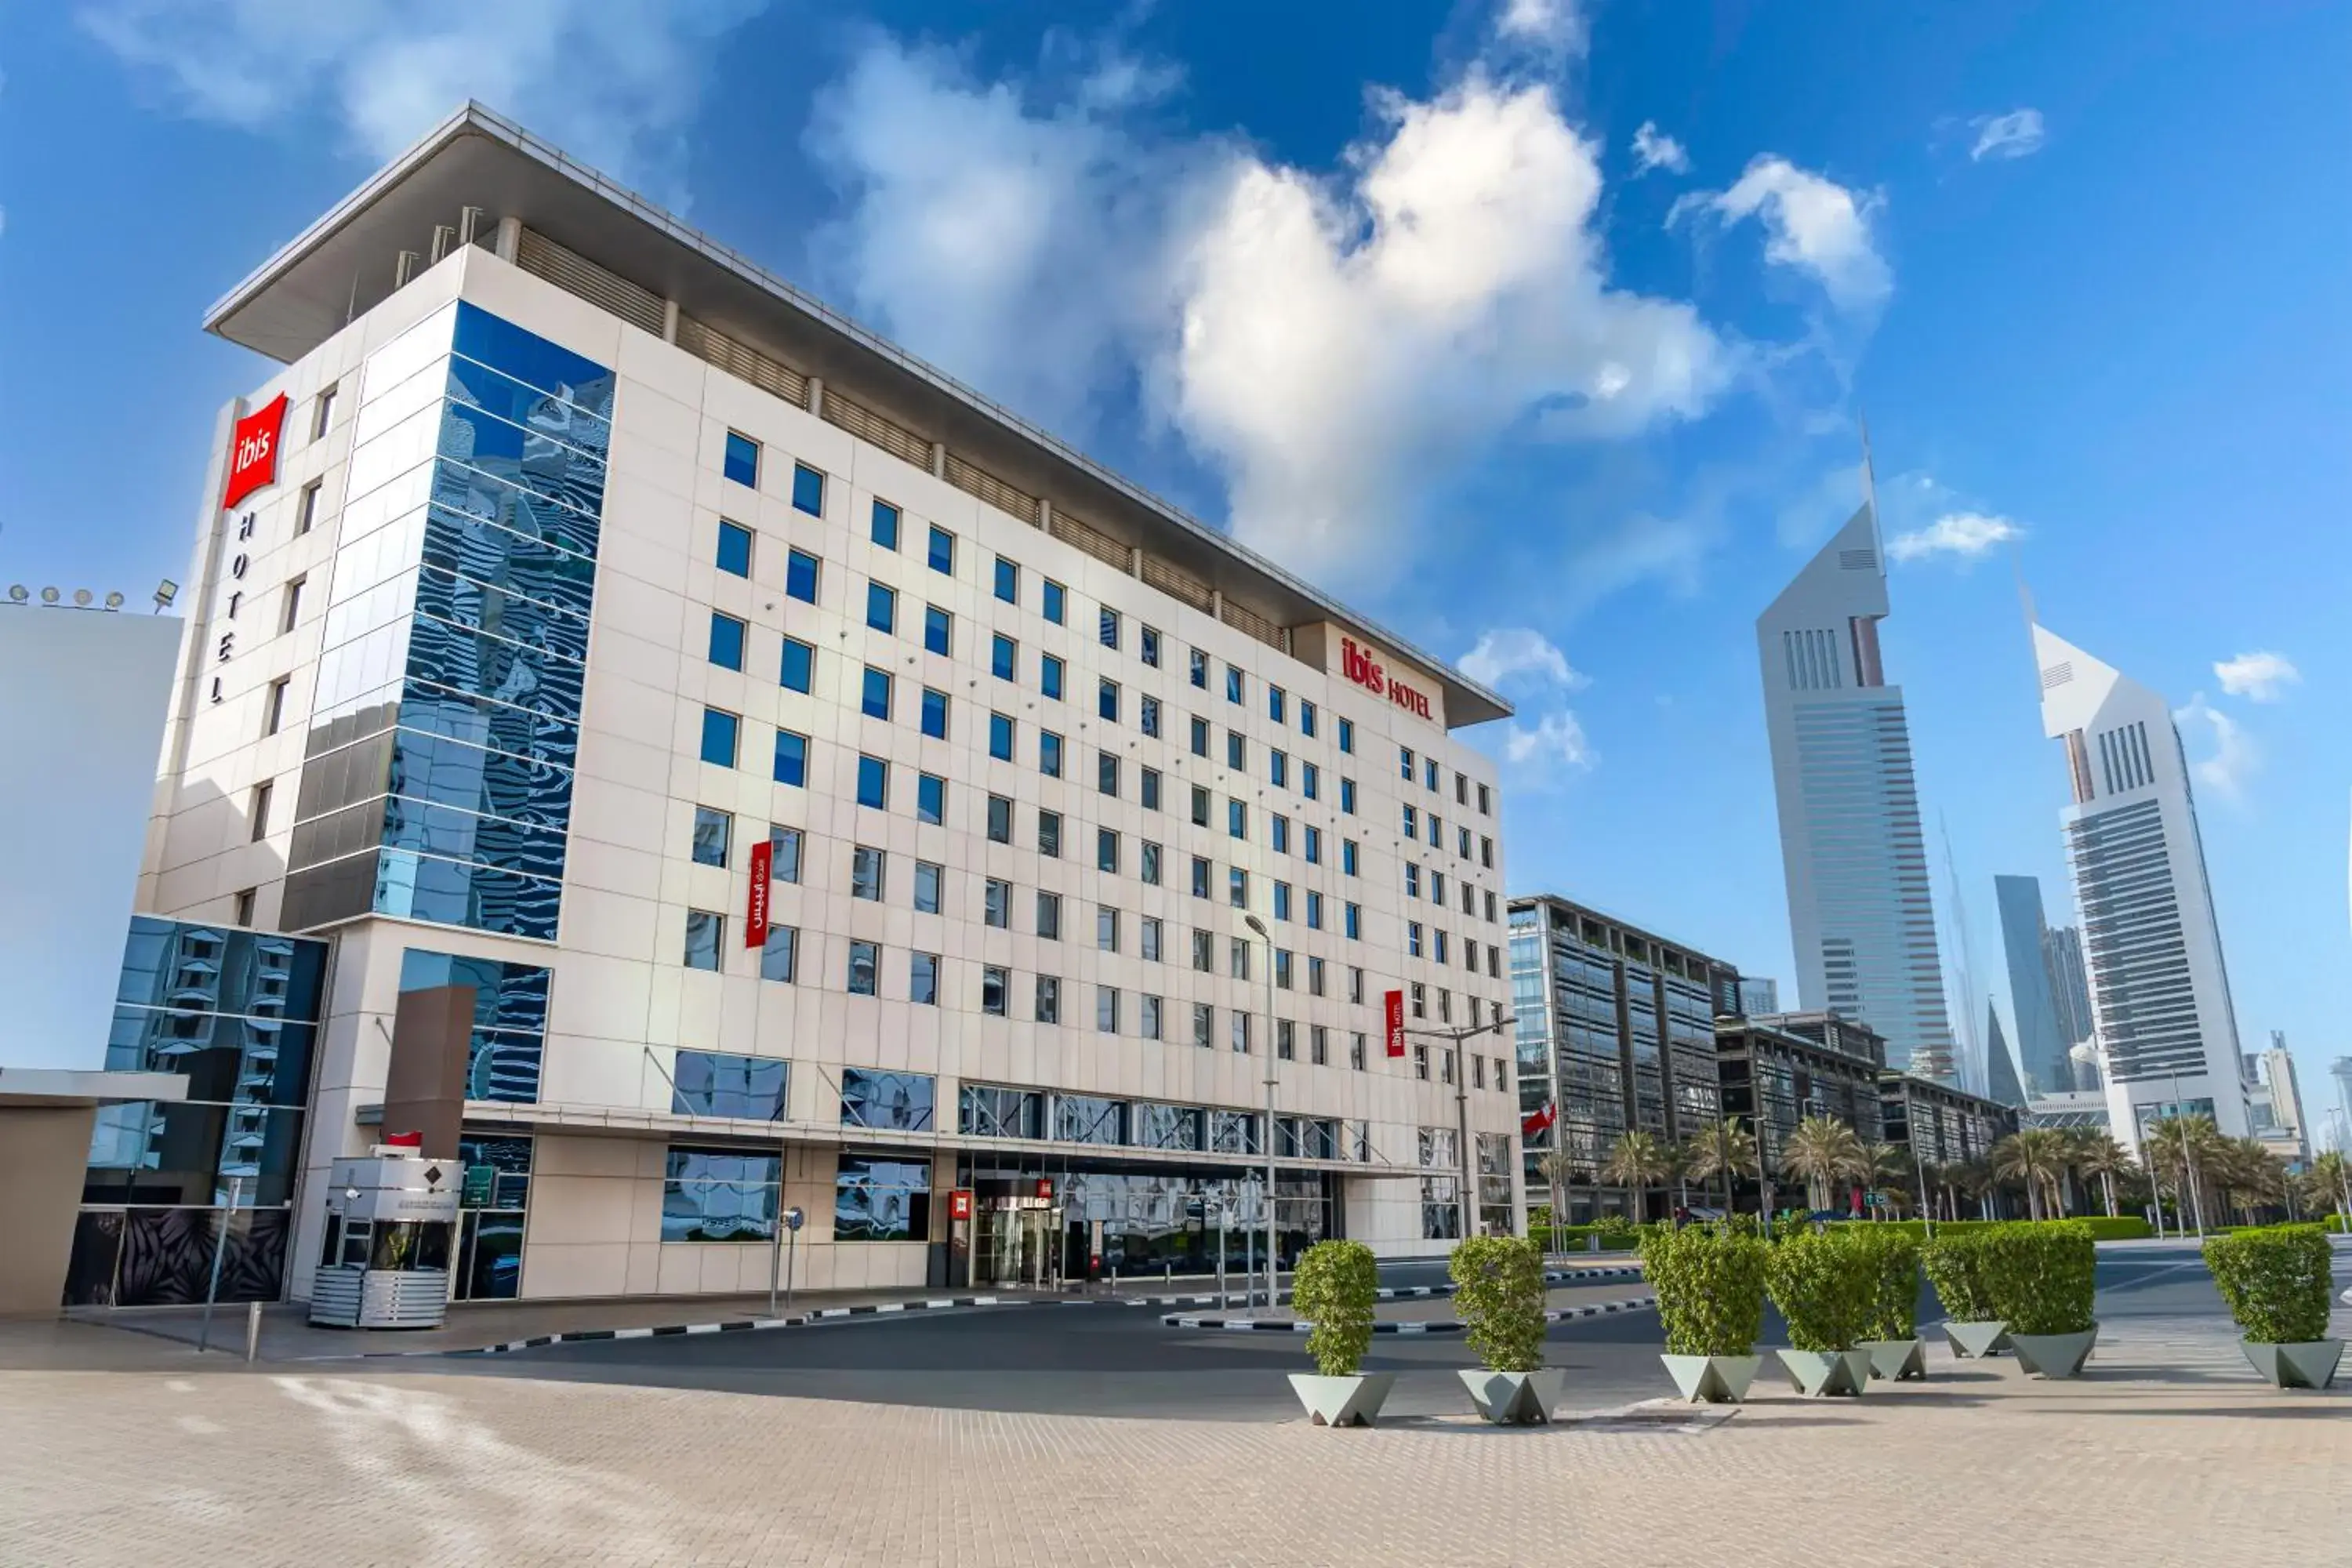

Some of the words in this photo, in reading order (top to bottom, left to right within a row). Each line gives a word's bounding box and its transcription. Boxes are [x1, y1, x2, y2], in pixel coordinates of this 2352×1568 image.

[236, 429, 271, 474] ibis
[209, 511, 256, 703] HOTEL
[1341, 637, 1385, 694] ibis
[1388, 677, 1433, 720] HOTEL
[1393, 1003, 1402, 1025] HOTEL
[1392, 1027, 1402, 1047] ibis
